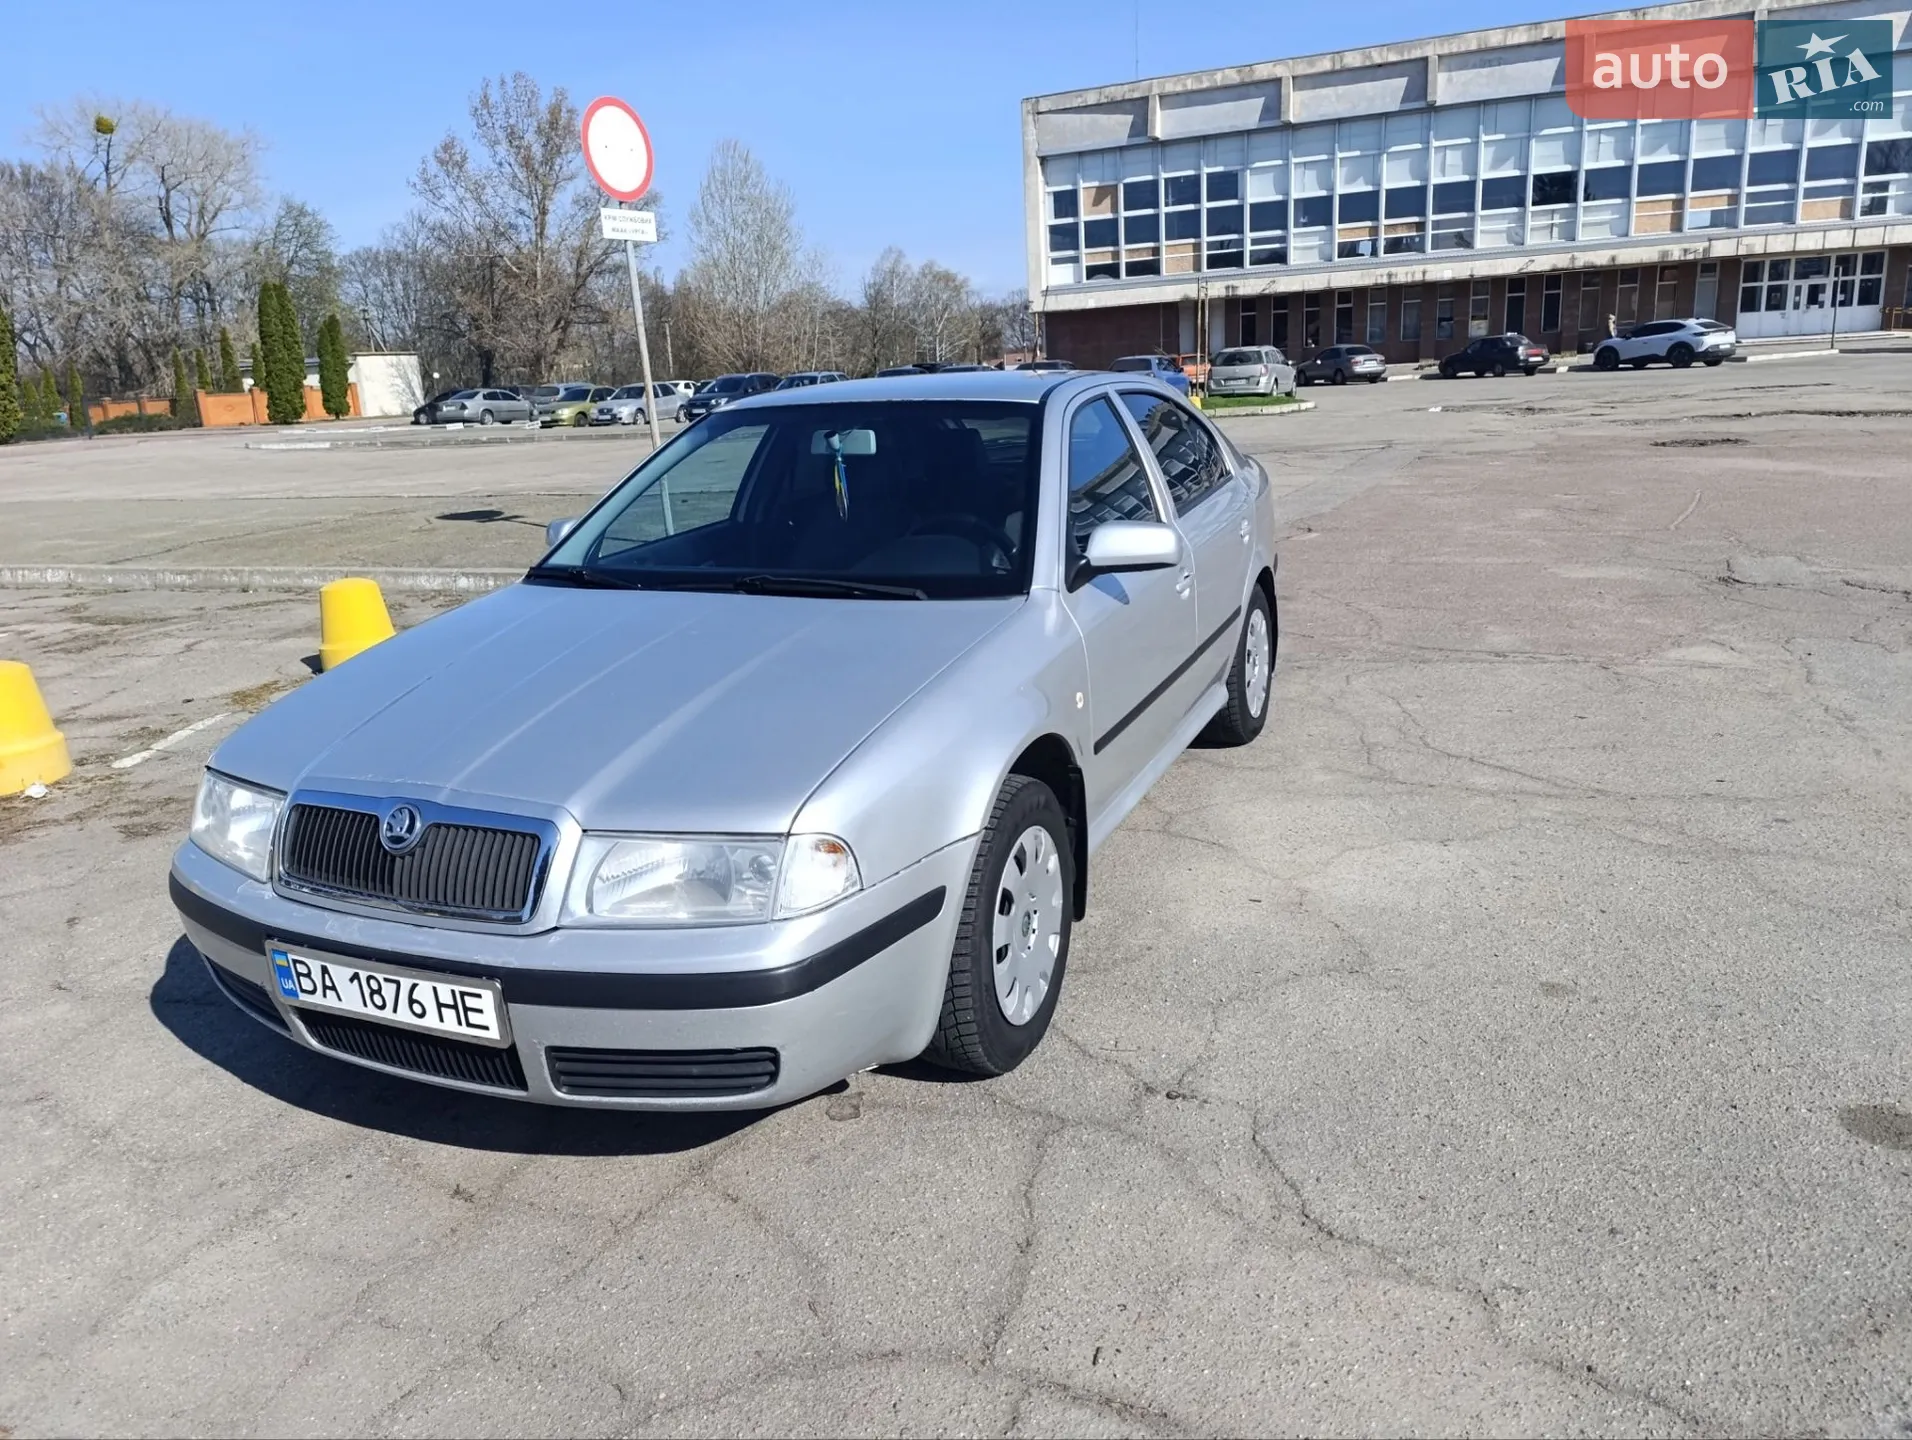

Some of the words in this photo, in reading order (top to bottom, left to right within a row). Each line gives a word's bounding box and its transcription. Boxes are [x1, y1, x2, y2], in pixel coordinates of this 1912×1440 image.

[280, 977, 296, 991] UA
[291, 958, 342, 1002] BA
[349, 971, 427, 1019] 1876
[432, 985, 490, 1031] HE
